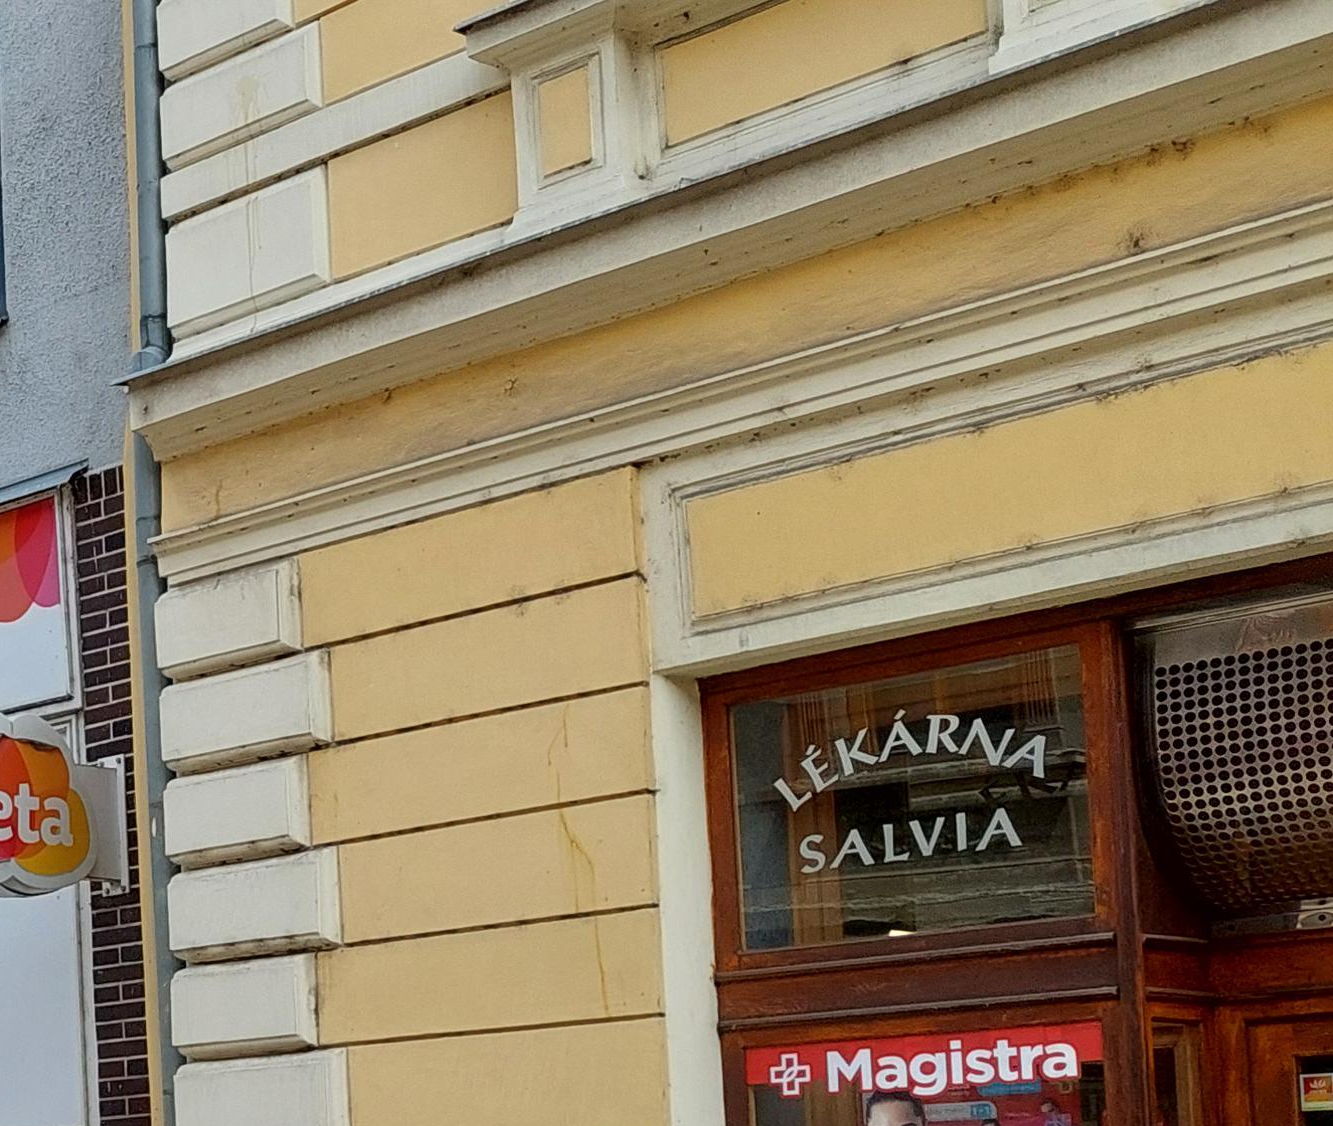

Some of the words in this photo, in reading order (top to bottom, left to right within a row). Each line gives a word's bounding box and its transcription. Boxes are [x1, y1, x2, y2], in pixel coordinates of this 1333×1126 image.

[773, 709, 1047, 813] LÉKÁRNA
[799, 807, 1022, 874] SALVIA
[827, 1039, 1079, 1096] Magistra
